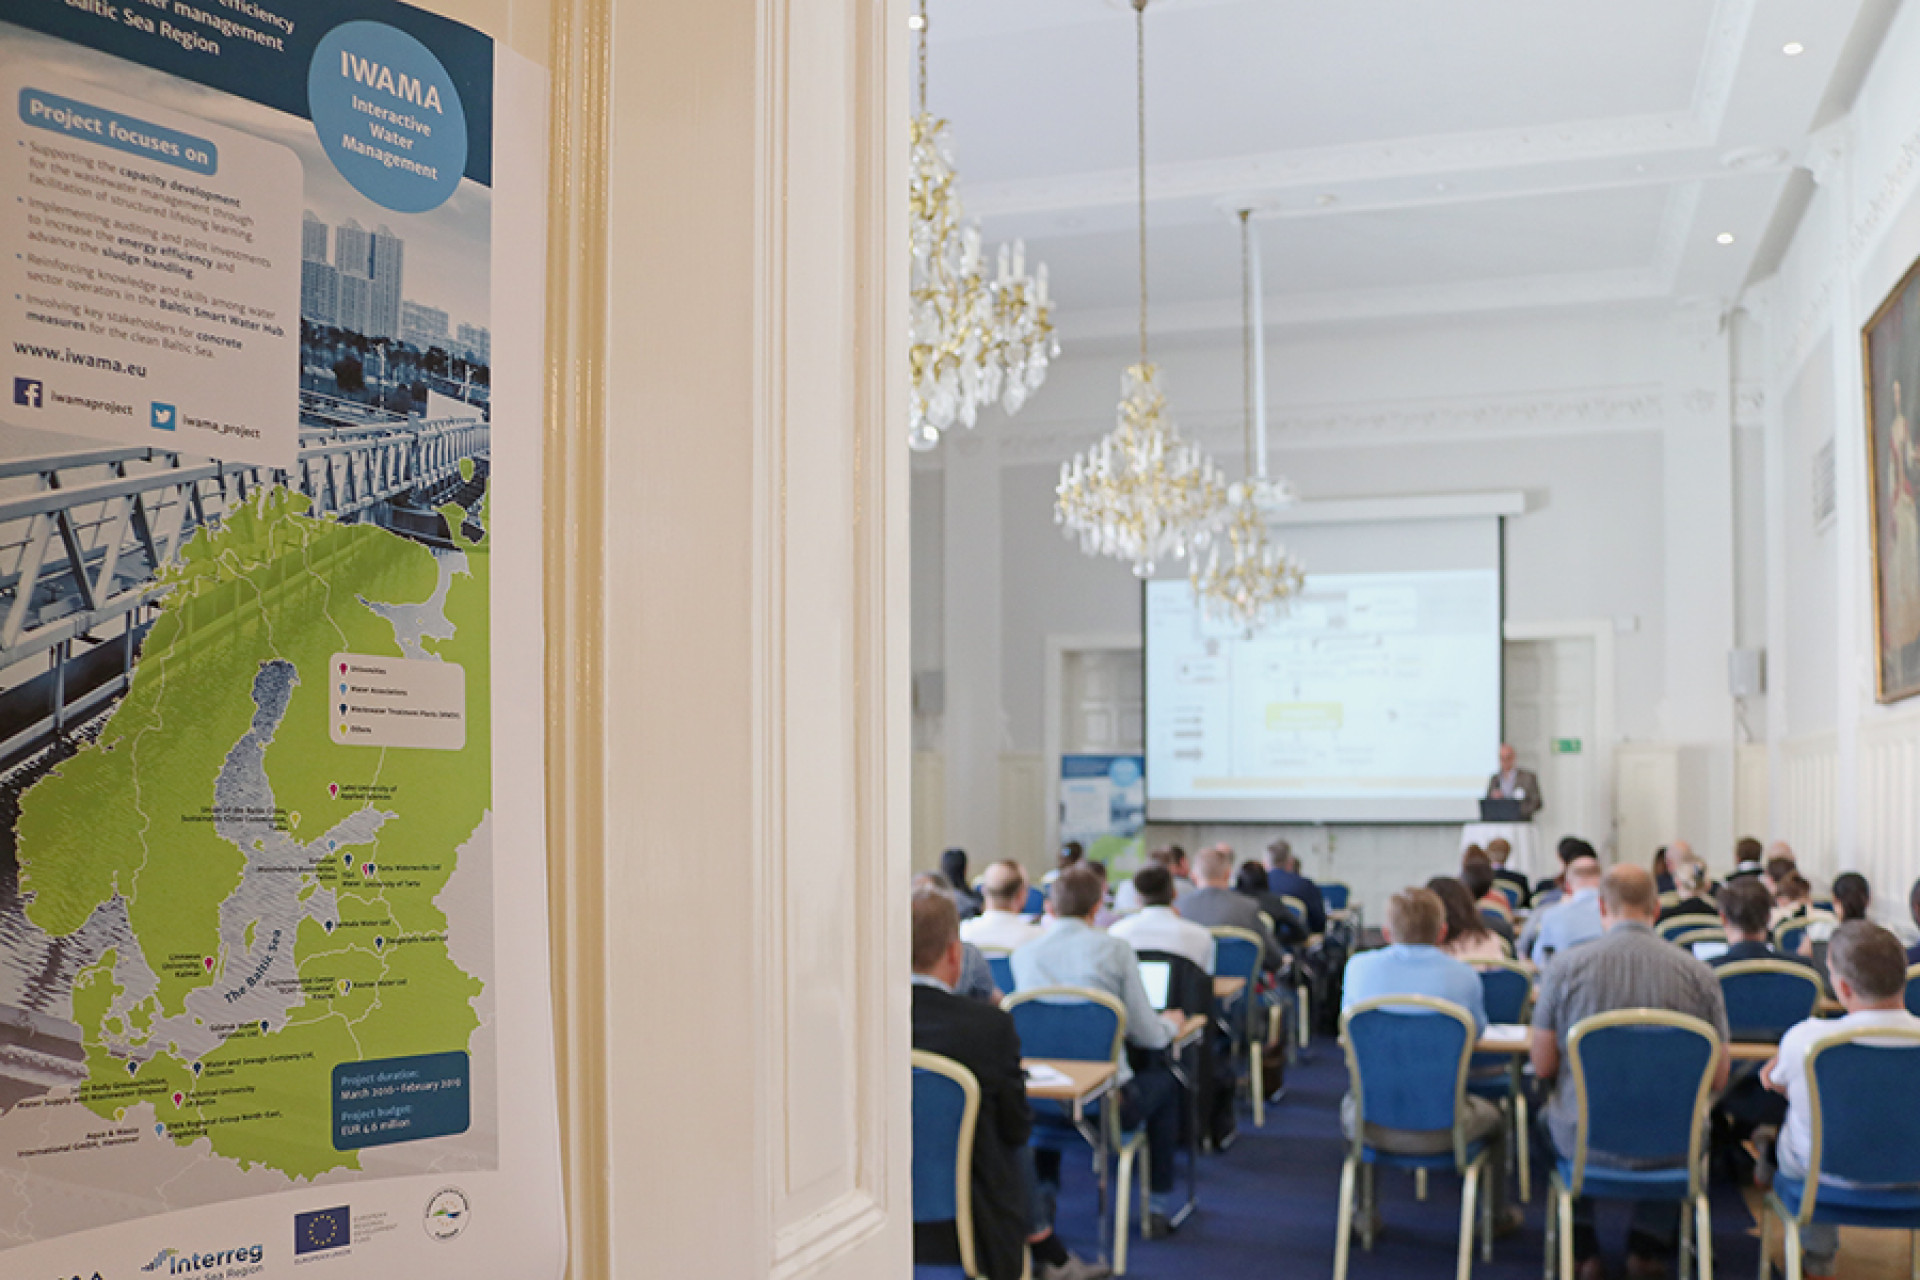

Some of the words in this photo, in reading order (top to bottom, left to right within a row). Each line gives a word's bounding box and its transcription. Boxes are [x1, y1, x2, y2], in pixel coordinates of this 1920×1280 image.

[123, 8, 155, 34] Sea
[159, 20, 221, 55] Region
[174, 2, 285, 52] management
[340, 50, 443, 115] IWAMA
[29, 98, 103, 135] Project
[352, 95, 432, 137] Interactive
[108, 120, 180, 157] focuses
[369, 121, 414, 150] Water
[184, 147, 209, 165] on
[342, 133, 438, 180] Management
[51, 163, 70, 177] the
[141, 188, 210, 215] management
[98, 159, 116, 173] the
[118, 167, 166, 190] capacity
[170, 181, 241, 208] development
[79, 241, 99, 255] the
[102, 247, 140, 266] sludge
[96, 229, 115, 243] the
[117, 236, 157, 254] energy
[160, 247, 213, 270] efficiency
[215, 260, 236, 274] and
[161, 232, 182, 245] and
[160, 284, 180, 298] and
[26, 312, 86, 332] measures
[108, 327, 128, 340] the
[138, 294, 157, 307] the
[160, 298, 191, 316] Baltic
[194, 307, 227, 324] Smart
[228, 315, 260, 332] Water
[12, 341, 147, 378] www.iwama.eu
[196, 332, 242, 350] concrete
[51, 390, 133, 416] iwamaproject
[183, 413, 261, 439] iwama_project
[223, 985, 246, 1003] The
[245, 955, 273, 988] Baltic
[268, 929, 281, 952] Sea
[170, 1244, 263, 1275] Interreg
